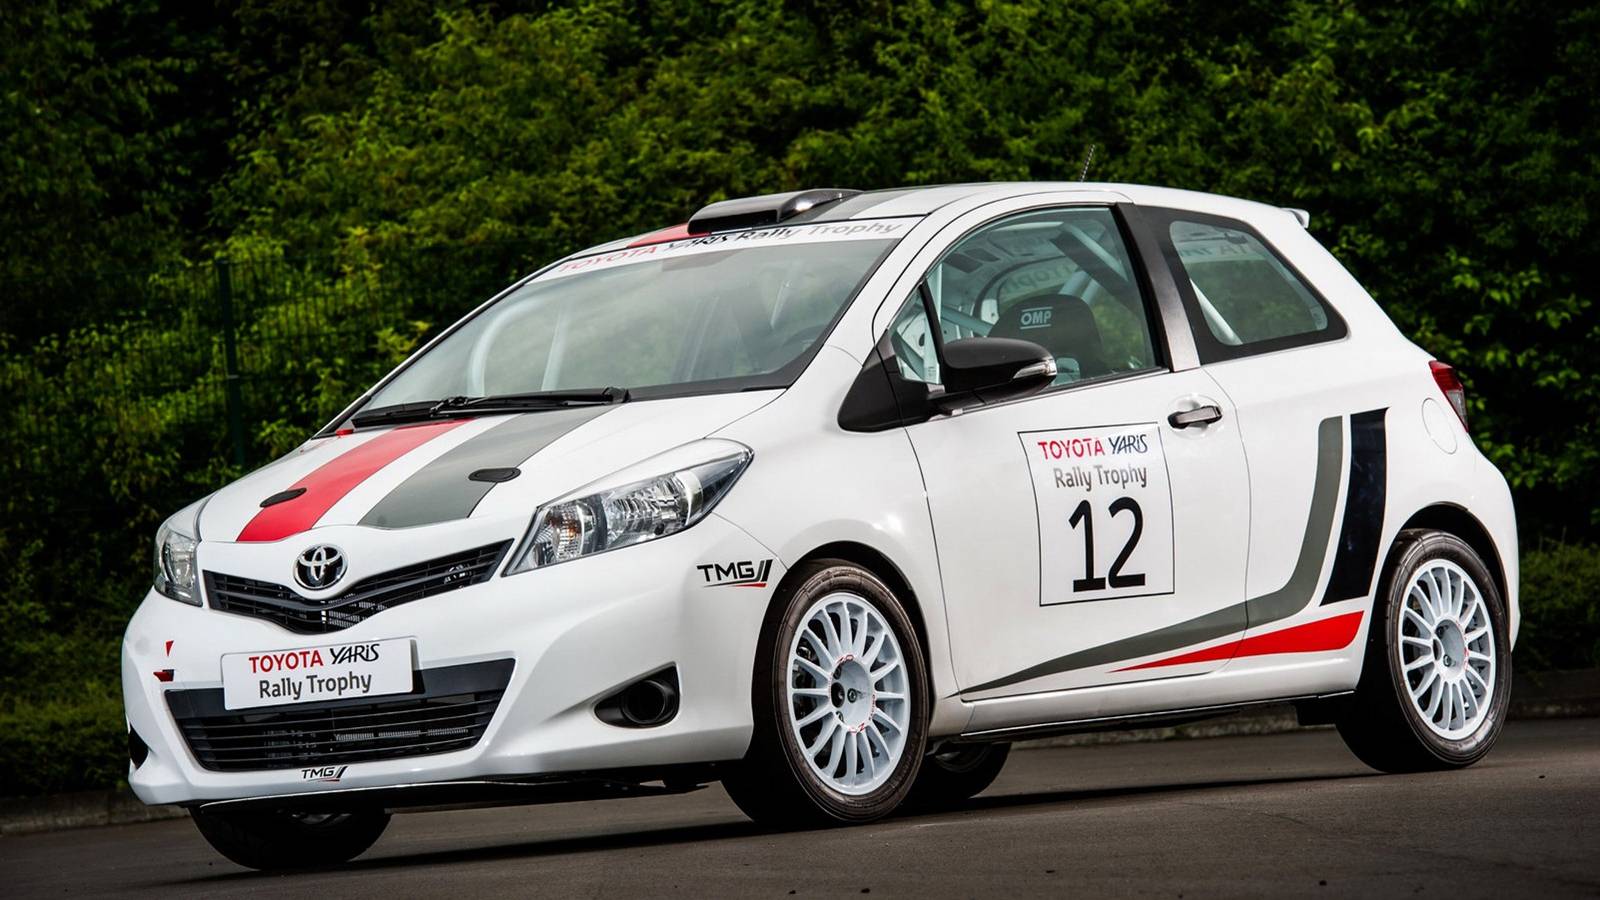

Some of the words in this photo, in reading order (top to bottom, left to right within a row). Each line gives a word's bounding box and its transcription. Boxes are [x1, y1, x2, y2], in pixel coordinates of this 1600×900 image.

[559, 246, 656, 271] TOYOTA
[735, 228, 798, 241] Rally
[808, 222, 902, 237] Trophy
[1020, 310, 1052, 325] OMP
[1038, 438, 1105, 460] TOYOTA
[1053, 466, 1092, 492] Rally
[1094, 462, 1147, 489] Trophy
[1068, 496, 1146, 592] 12
[696, 561, 755, 582] TMG
[249, 650, 323, 673] TOYOTA
[259, 678, 302, 700] Rally
[306, 671, 372, 695] Trophy
[301, 766, 335, 779] TMG
